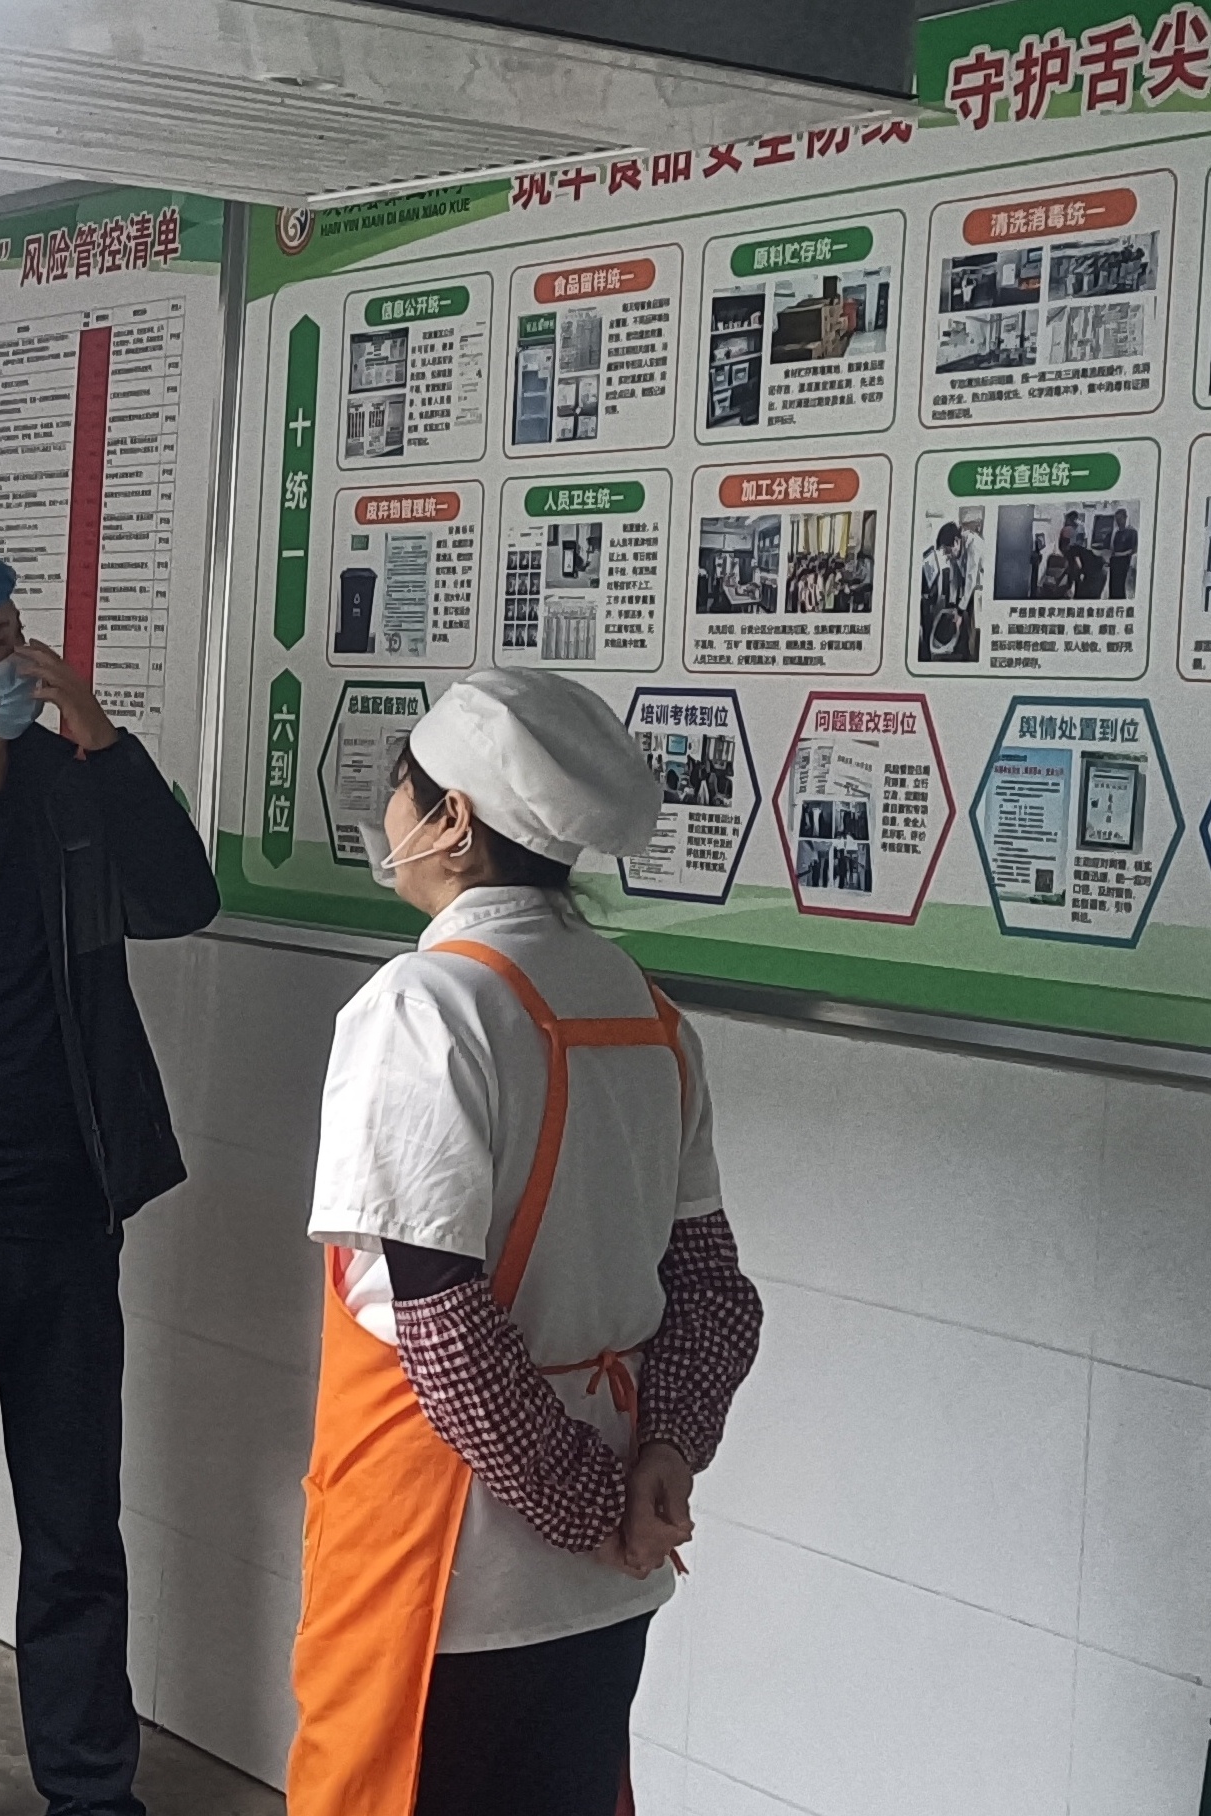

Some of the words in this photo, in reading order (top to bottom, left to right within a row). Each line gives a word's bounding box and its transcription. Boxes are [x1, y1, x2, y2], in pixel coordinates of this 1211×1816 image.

[950, 10, 1209, 131] 守护舌尖
[361, 213, 385, 229] XIAN
[422, 202, 447, 219] XIAO
[448, 198, 471, 214] XUE
[990, 201, 1106, 237] 清洗消毒统一
[753, 237, 848, 270] 原料贮存统一
[553, 268, 635, 297] 食品留样统一
[381, 294, 452, 321] 信息公开统一
[282, 408, 311, 558] 十统一
[741, 476, 835, 502] 加工分餐统一
[975, 462, 1089, 490] 进货查验统一
[366, 497, 449, 520] 废弃物管理统一
[543, 488, 625, 512] 人员卫生统一
[640, 703, 729, 727] 培训考核到位
[814, 710, 917, 735] 问题整改到位
[1018, 715, 1139, 743] 舆情处置到位
[267, 703, 296, 834] 六到位
